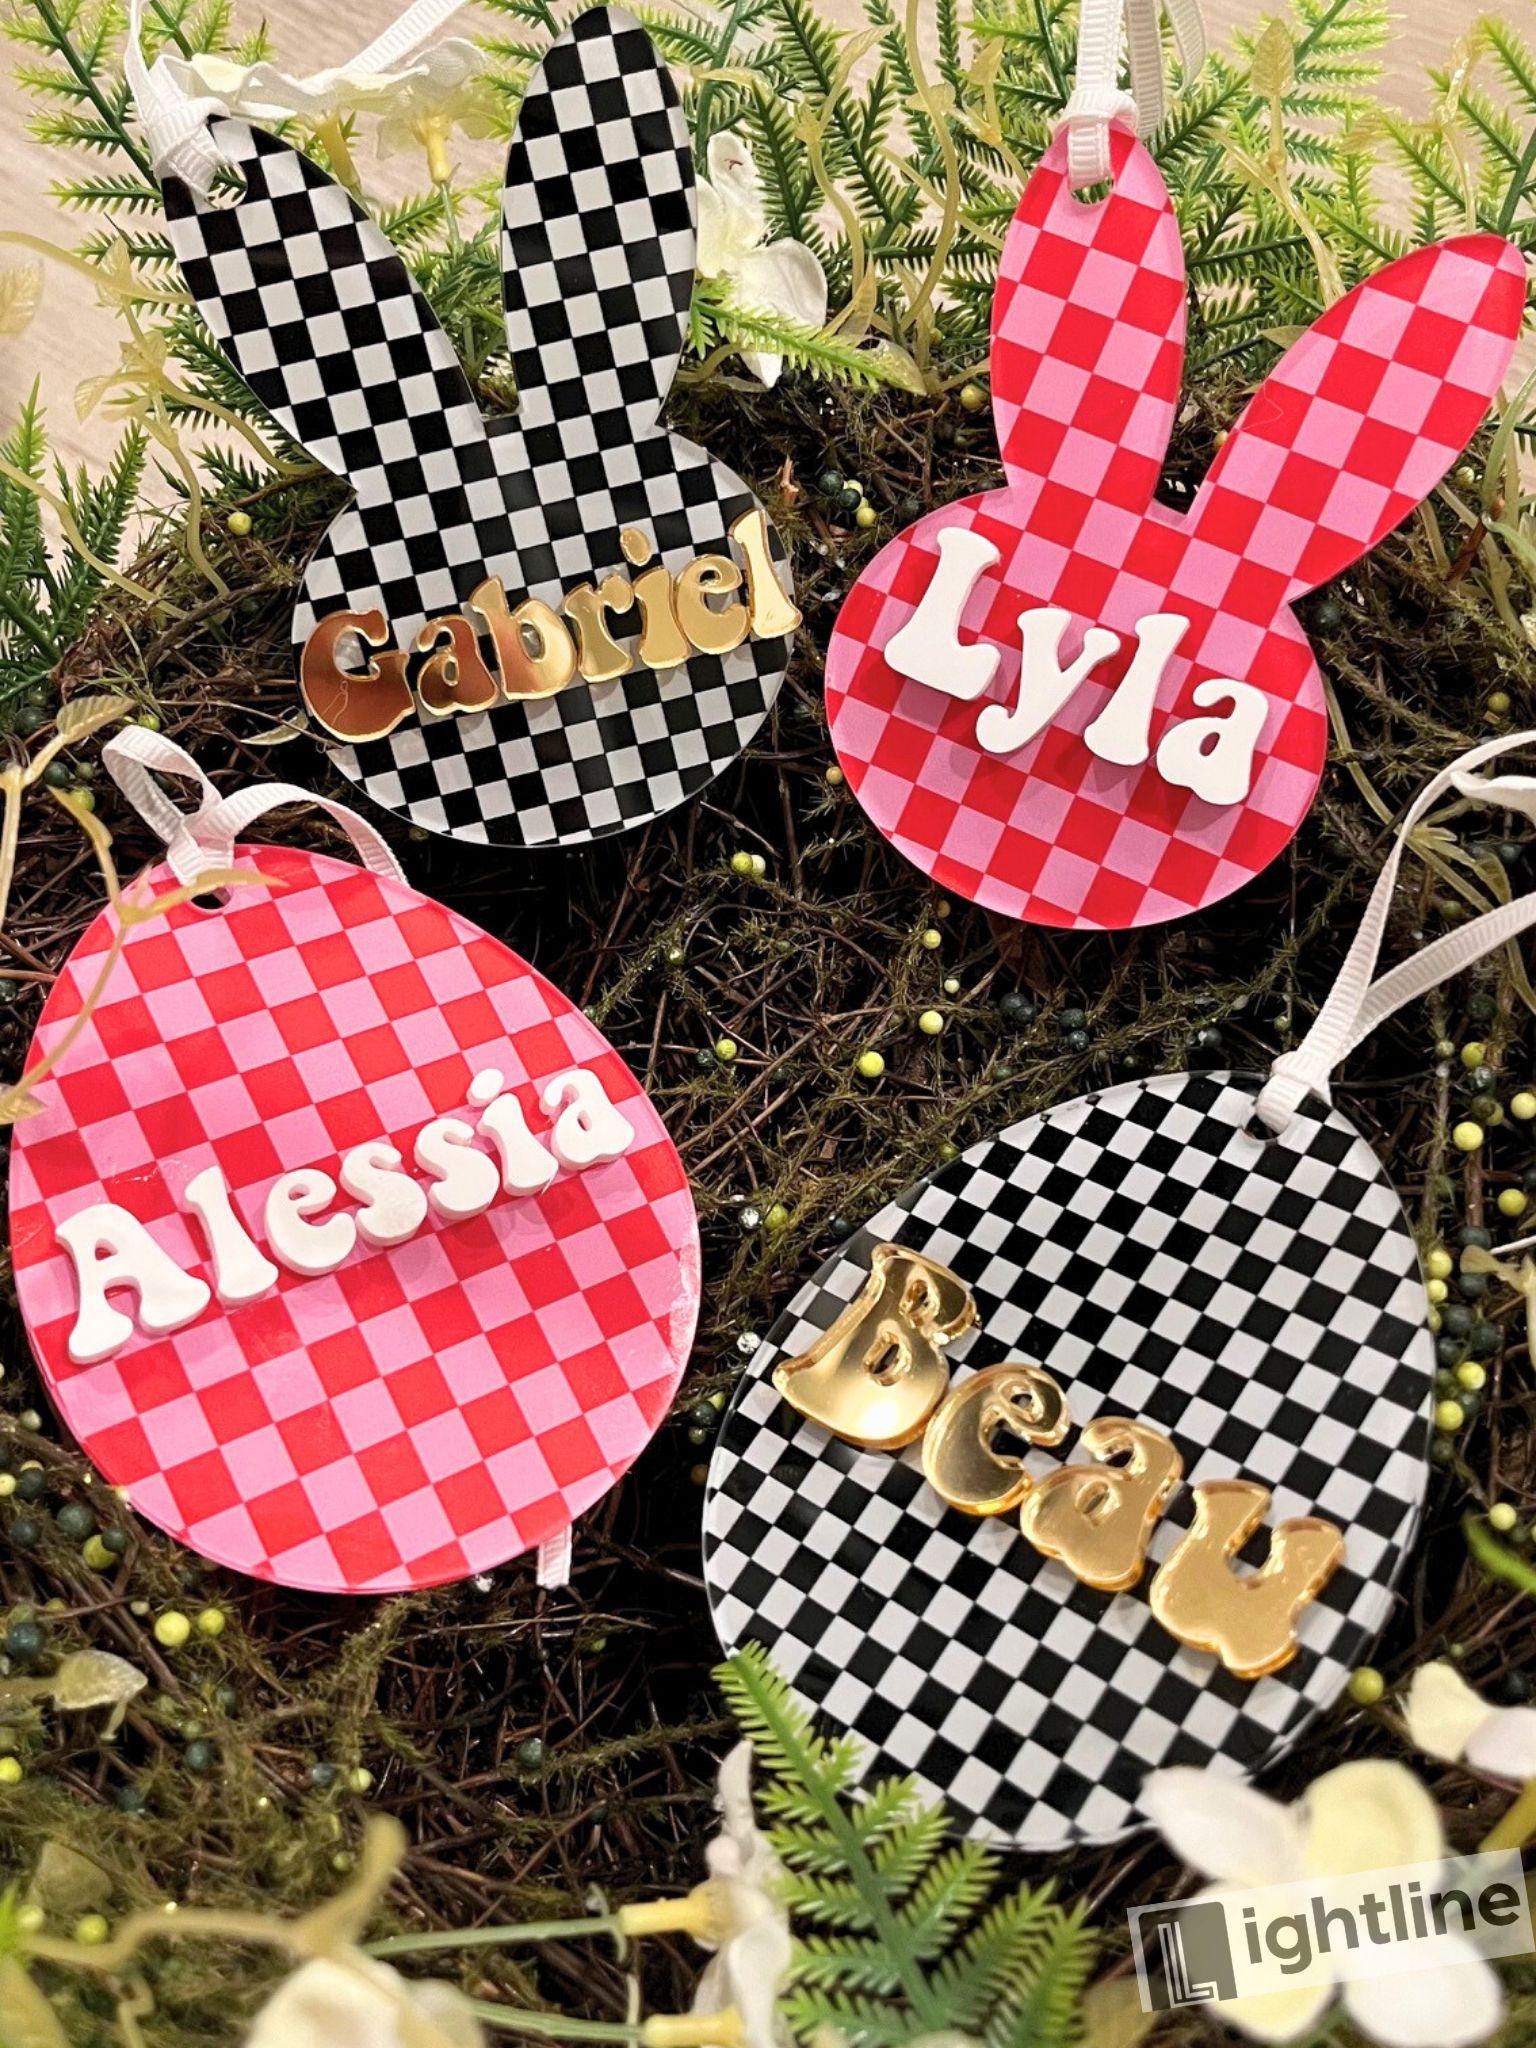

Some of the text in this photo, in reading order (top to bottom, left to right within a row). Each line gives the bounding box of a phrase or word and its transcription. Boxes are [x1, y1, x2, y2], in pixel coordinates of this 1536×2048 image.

[300, 509, 801, 743] Gabriel
[884, 527, 1268, 805] Lyla
[56, 1068, 634, 1364] Alessia
[772, 1243, 1345, 1679] Beau
